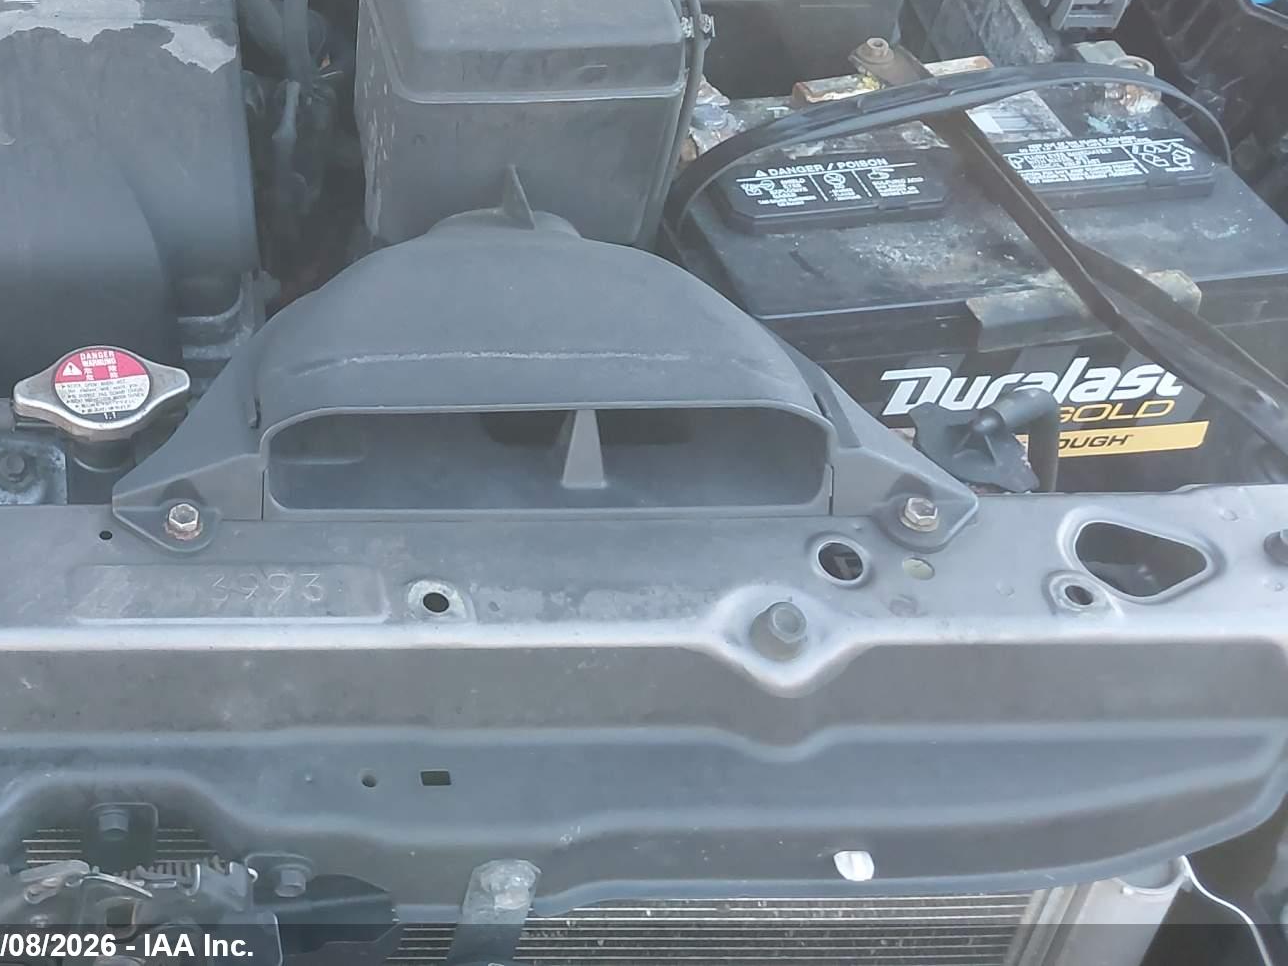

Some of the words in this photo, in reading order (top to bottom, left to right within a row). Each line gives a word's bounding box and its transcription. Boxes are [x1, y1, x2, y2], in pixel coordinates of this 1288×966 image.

[768, 164, 825, 177] DANGER
[836, 157, 889, 170] POISON
[80, 351, 115, 359] DANGER
[1058, 434, 1129, 450] OUGH
